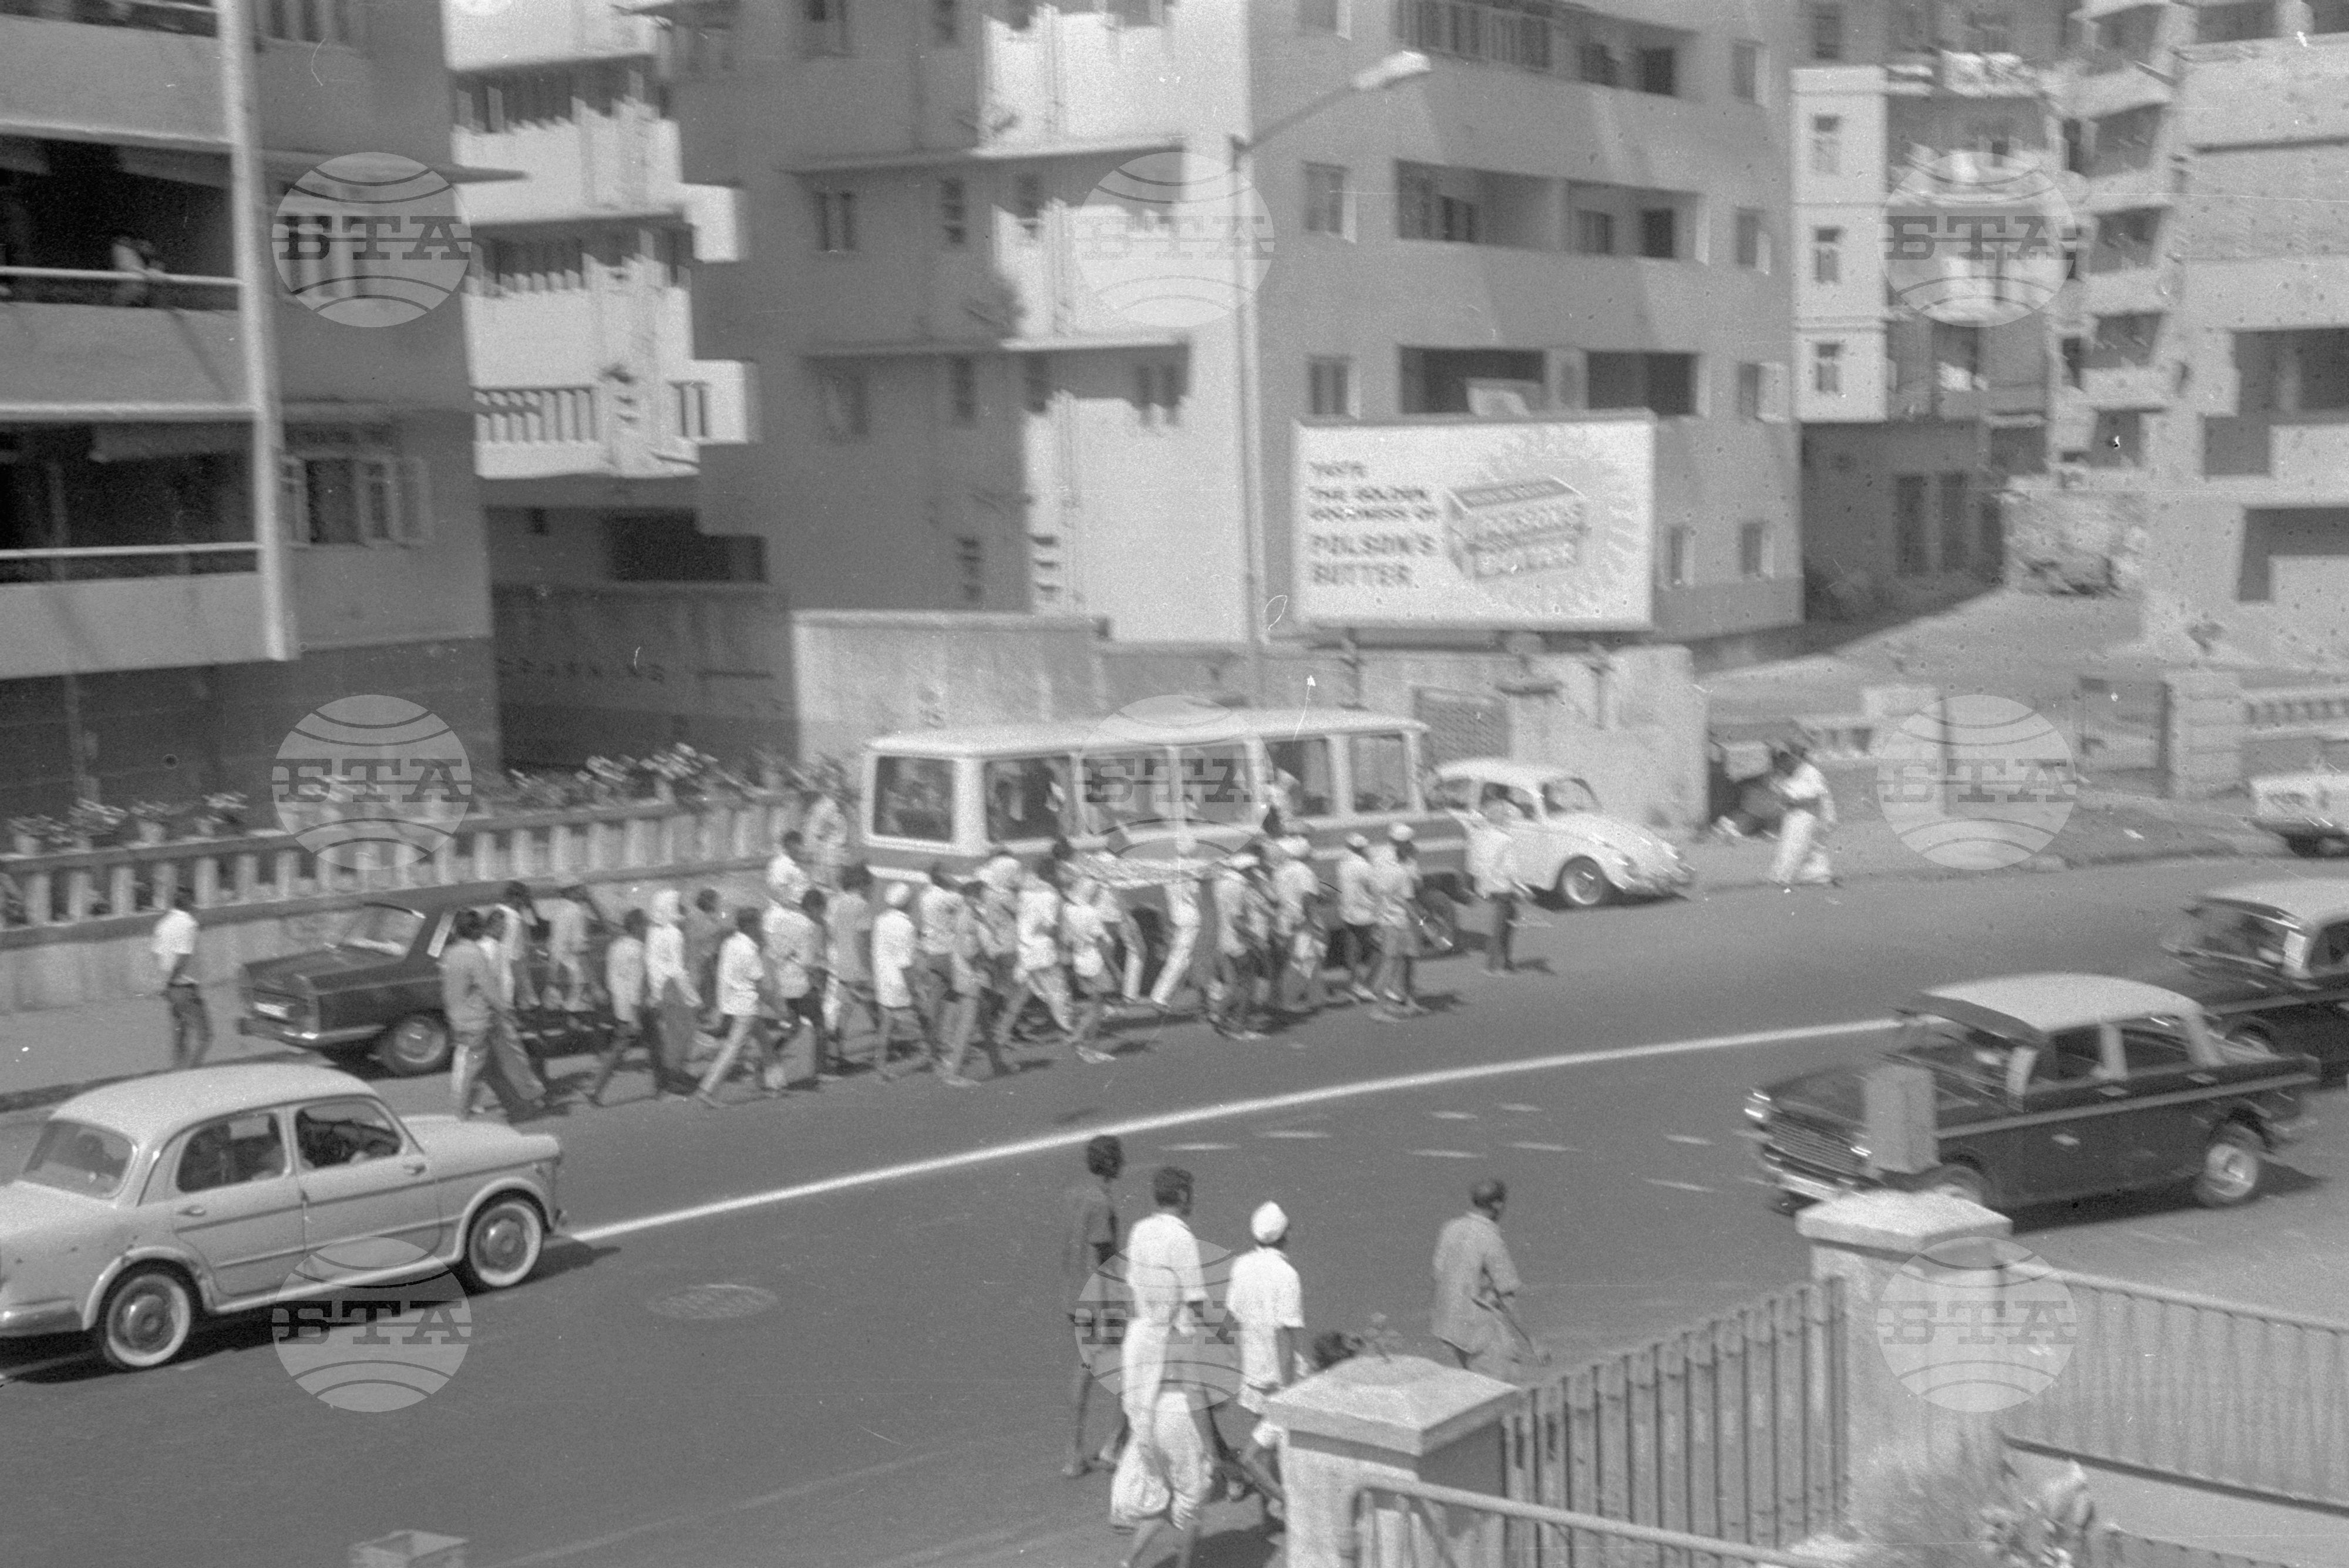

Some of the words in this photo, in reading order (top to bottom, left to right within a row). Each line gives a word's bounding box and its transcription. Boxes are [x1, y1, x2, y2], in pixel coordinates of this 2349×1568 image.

[1308, 486, 1348, 502] THE
[1310, 532, 1437, 557] POLSON'S
[1311, 562, 1414, 587] BUTTER
